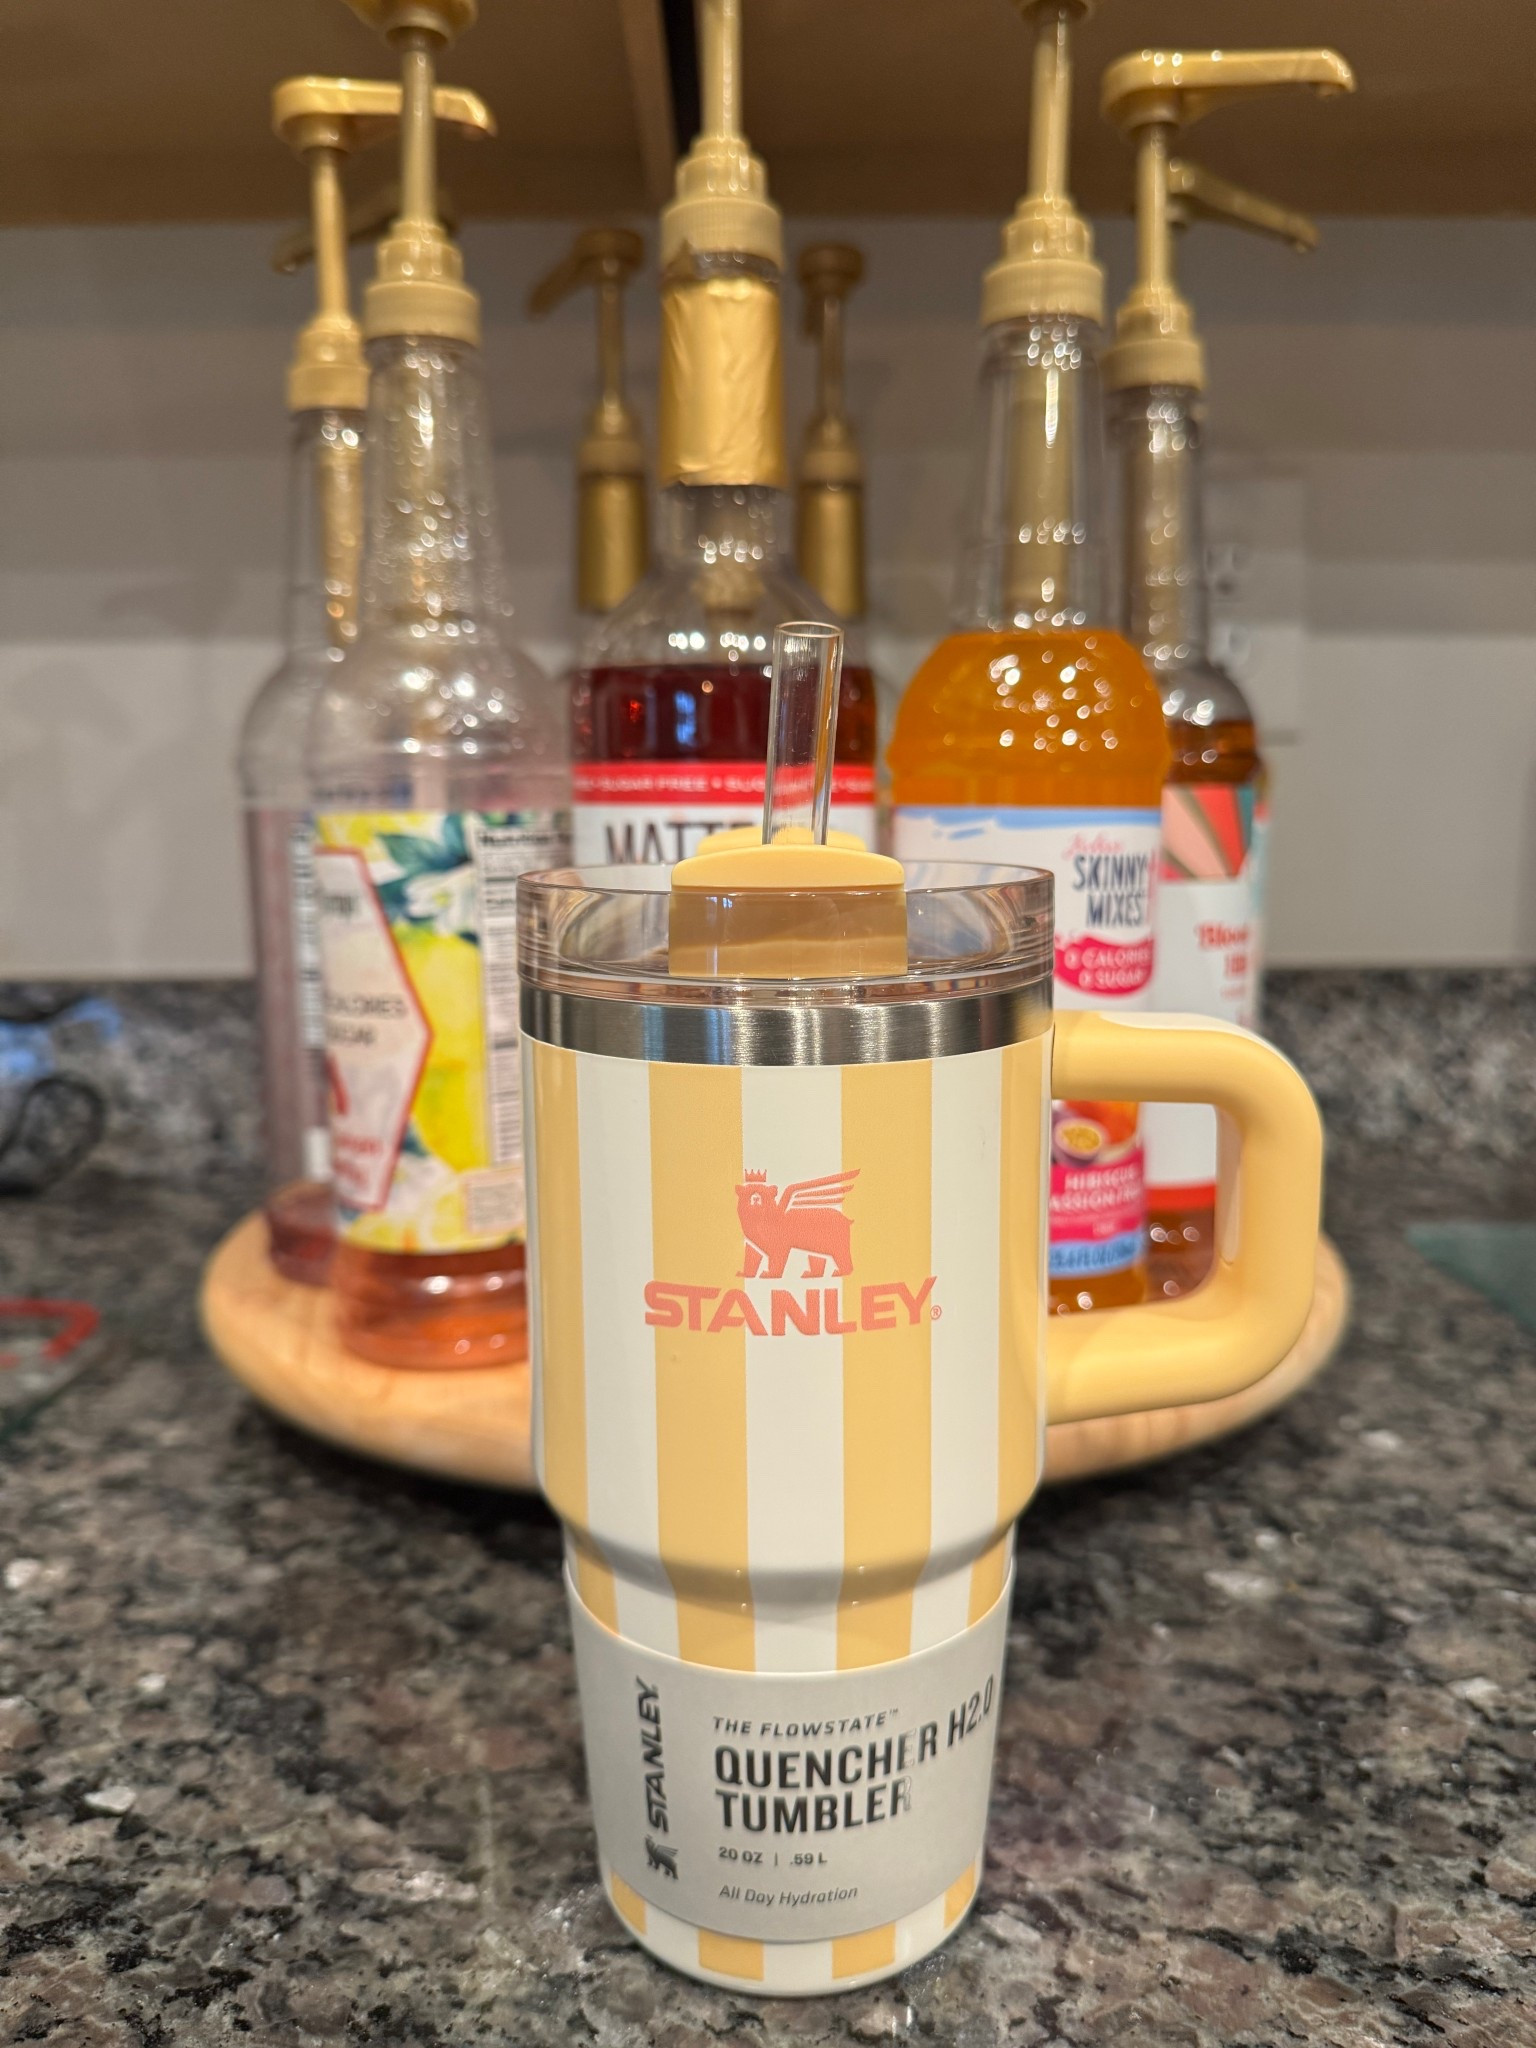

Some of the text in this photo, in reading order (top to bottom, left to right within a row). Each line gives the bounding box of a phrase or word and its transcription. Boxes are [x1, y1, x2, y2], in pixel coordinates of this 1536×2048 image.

[1073, 853, 1148, 892] SKINNY
[1086, 892, 1144, 928] MIXES
[713, 1716, 752, 1735] THE
[636, 1675, 670, 1833] STANLEY
[715, 1720, 937, 1789] QUENCHER
[715, 1775, 913, 1834] TUMBLER
[718, 1846, 738, 1861] 20
[742, 1850, 763, 1865] OZ
[818, 1851, 828, 1864] L
[719, 1884, 858, 1907] All Day Hydration
